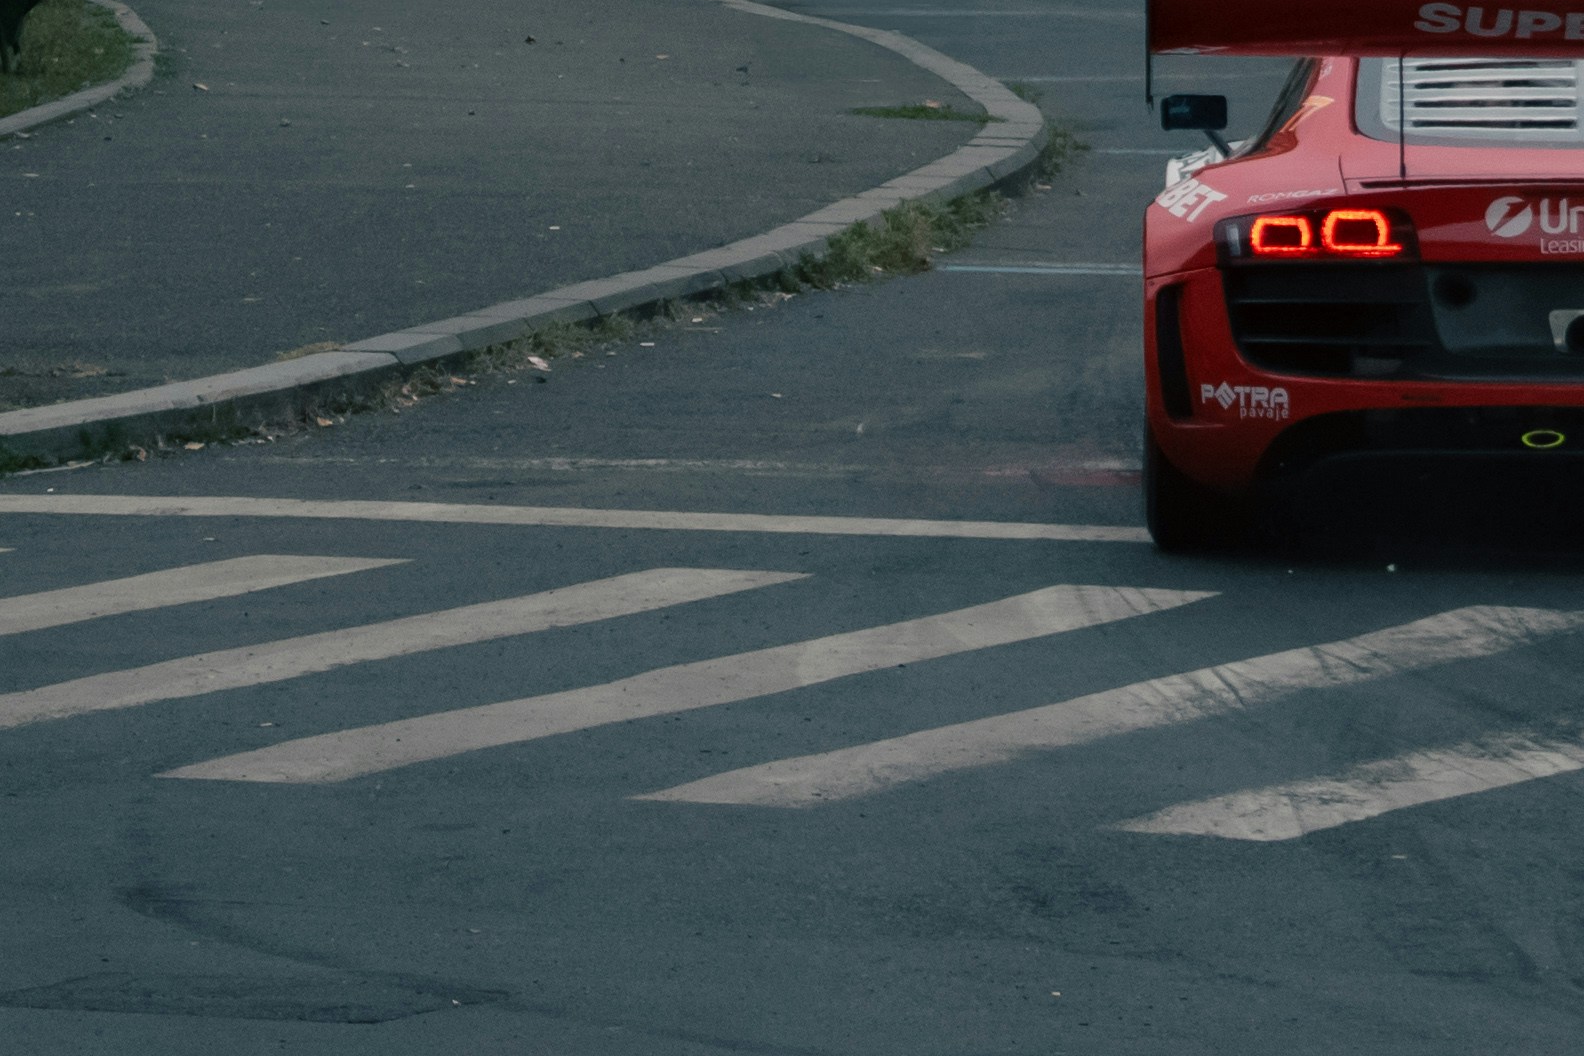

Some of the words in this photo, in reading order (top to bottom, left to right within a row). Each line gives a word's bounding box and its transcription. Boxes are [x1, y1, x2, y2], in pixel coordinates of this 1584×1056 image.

[1155, 178, 1228, 223] BET
[1247, 189, 1338, 204] ROMGAZ
[1240, 405, 1289, 421] pavaje
